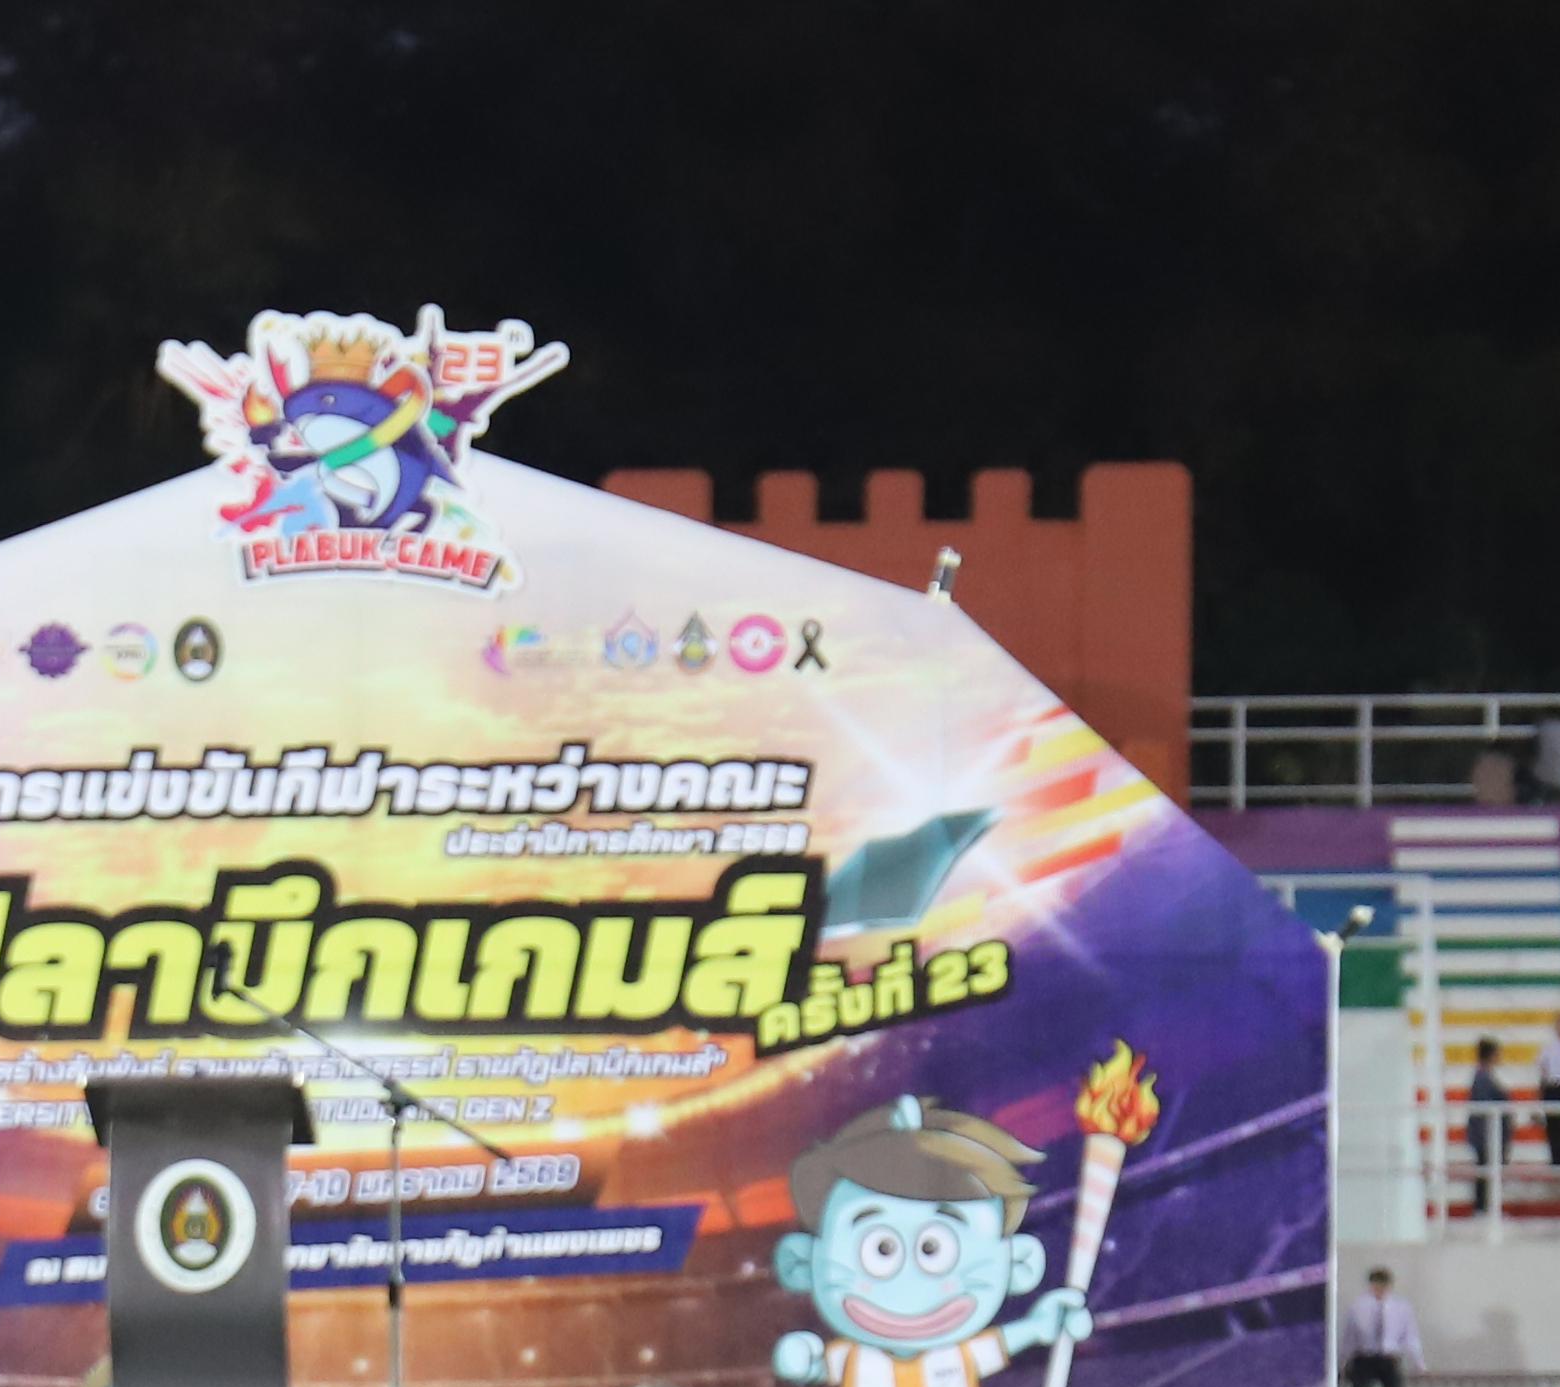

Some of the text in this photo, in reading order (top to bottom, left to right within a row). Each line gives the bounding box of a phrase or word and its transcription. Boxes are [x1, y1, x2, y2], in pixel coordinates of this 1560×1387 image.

[437, 343, 504, 384] 23
[391, 539, 500, 583] GAME
[924, 938, 1010, 1007] 23
